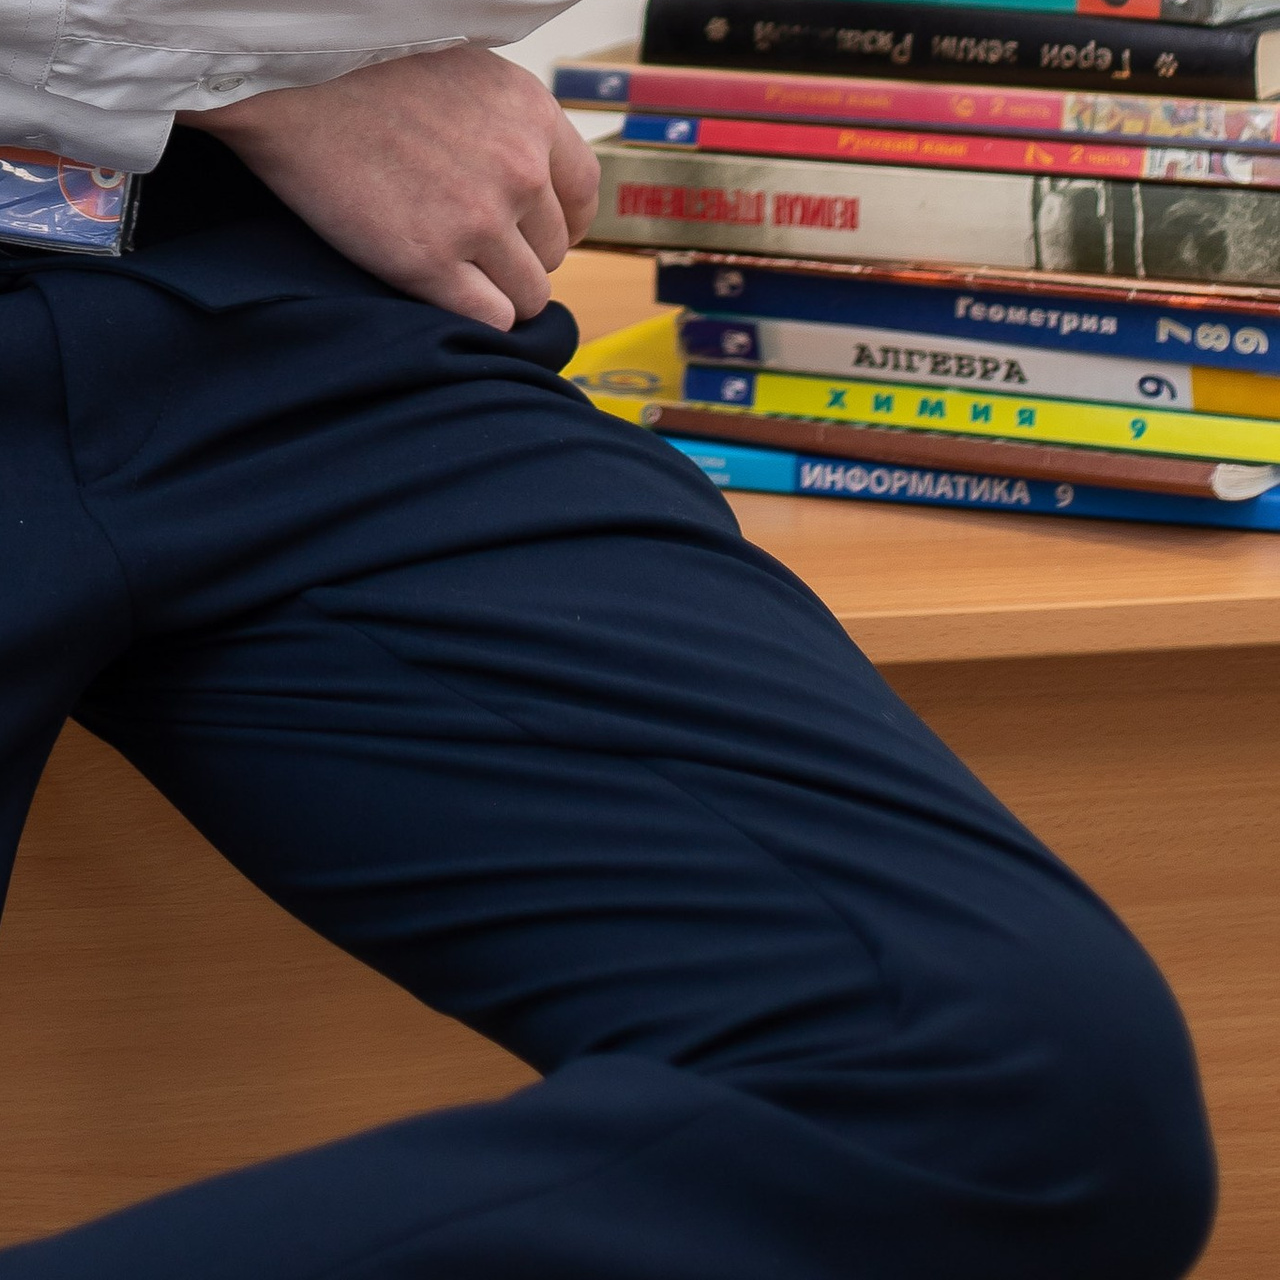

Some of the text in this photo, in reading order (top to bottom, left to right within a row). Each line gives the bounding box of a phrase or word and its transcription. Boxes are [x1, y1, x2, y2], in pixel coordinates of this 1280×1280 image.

[1039, 39, 1132, 80] Герои
[954, 296, 1119, 335] Геометрия
[852, 341, 1028, 386] АЛГЕБРА
[826, 387, 1148, 440] ХИМИЯ 9
[800, 461, 1075, 509] ИНФОРМАТИКА 9
